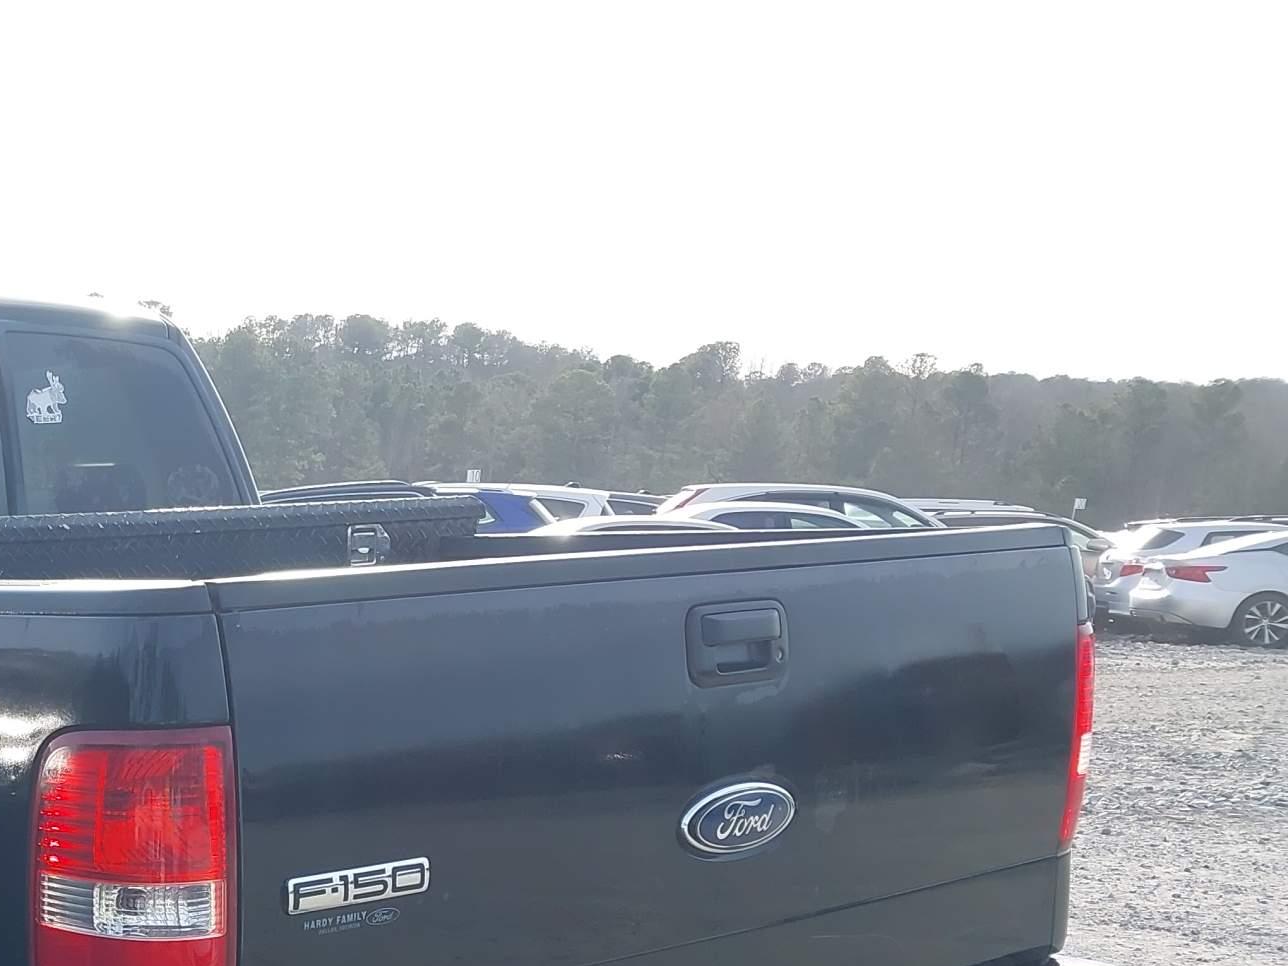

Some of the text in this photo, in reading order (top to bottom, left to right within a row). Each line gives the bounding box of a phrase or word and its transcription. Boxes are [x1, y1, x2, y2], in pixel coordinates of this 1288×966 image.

[716, 798, 775, 840] Ford
[290, 859, 427, 913] F-150
[303, 916, 334, 931] HARDY
[336, 911, 368, 927] FAMILY
[372, 910, 394, 924] Ford
